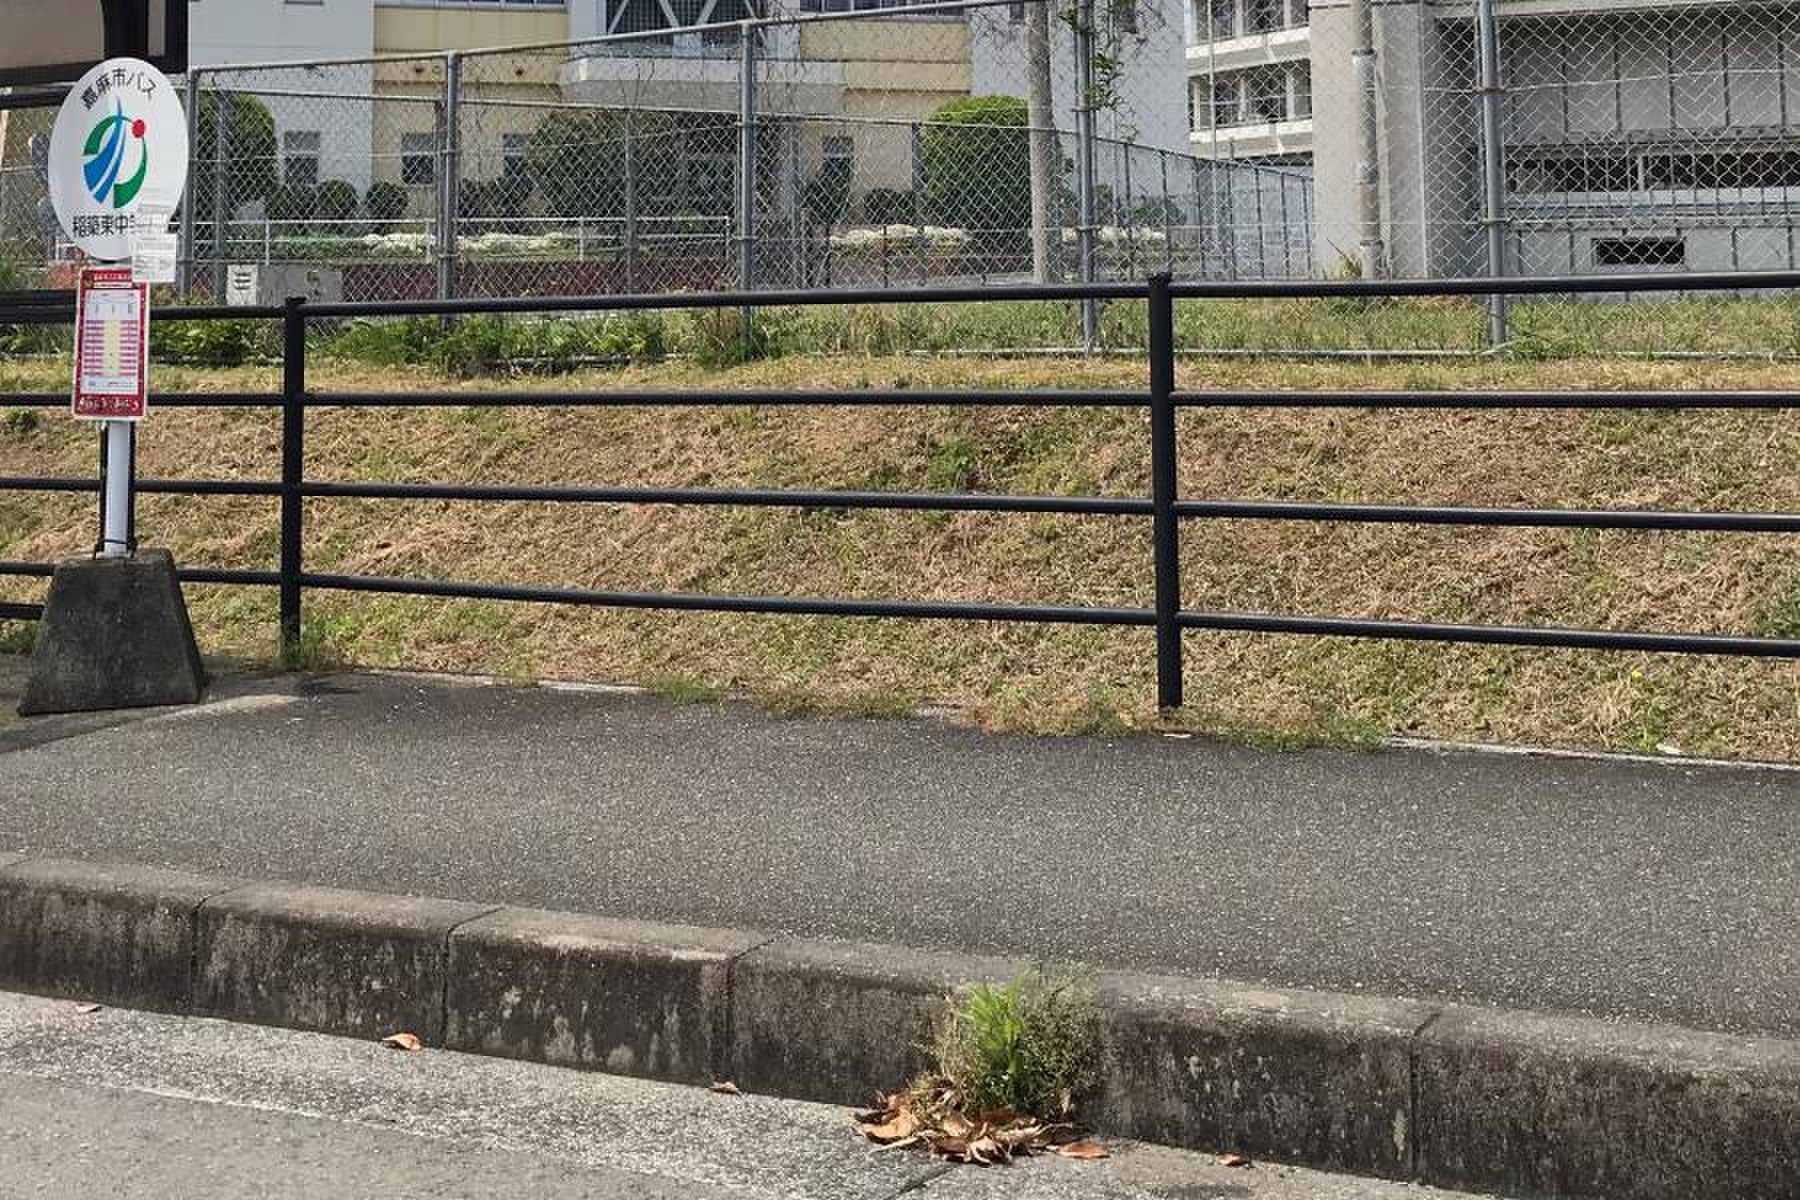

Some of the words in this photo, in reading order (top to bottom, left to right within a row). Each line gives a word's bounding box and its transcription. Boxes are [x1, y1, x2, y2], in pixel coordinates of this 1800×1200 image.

[81, 67, 157, 110] 嘉麻市バス
